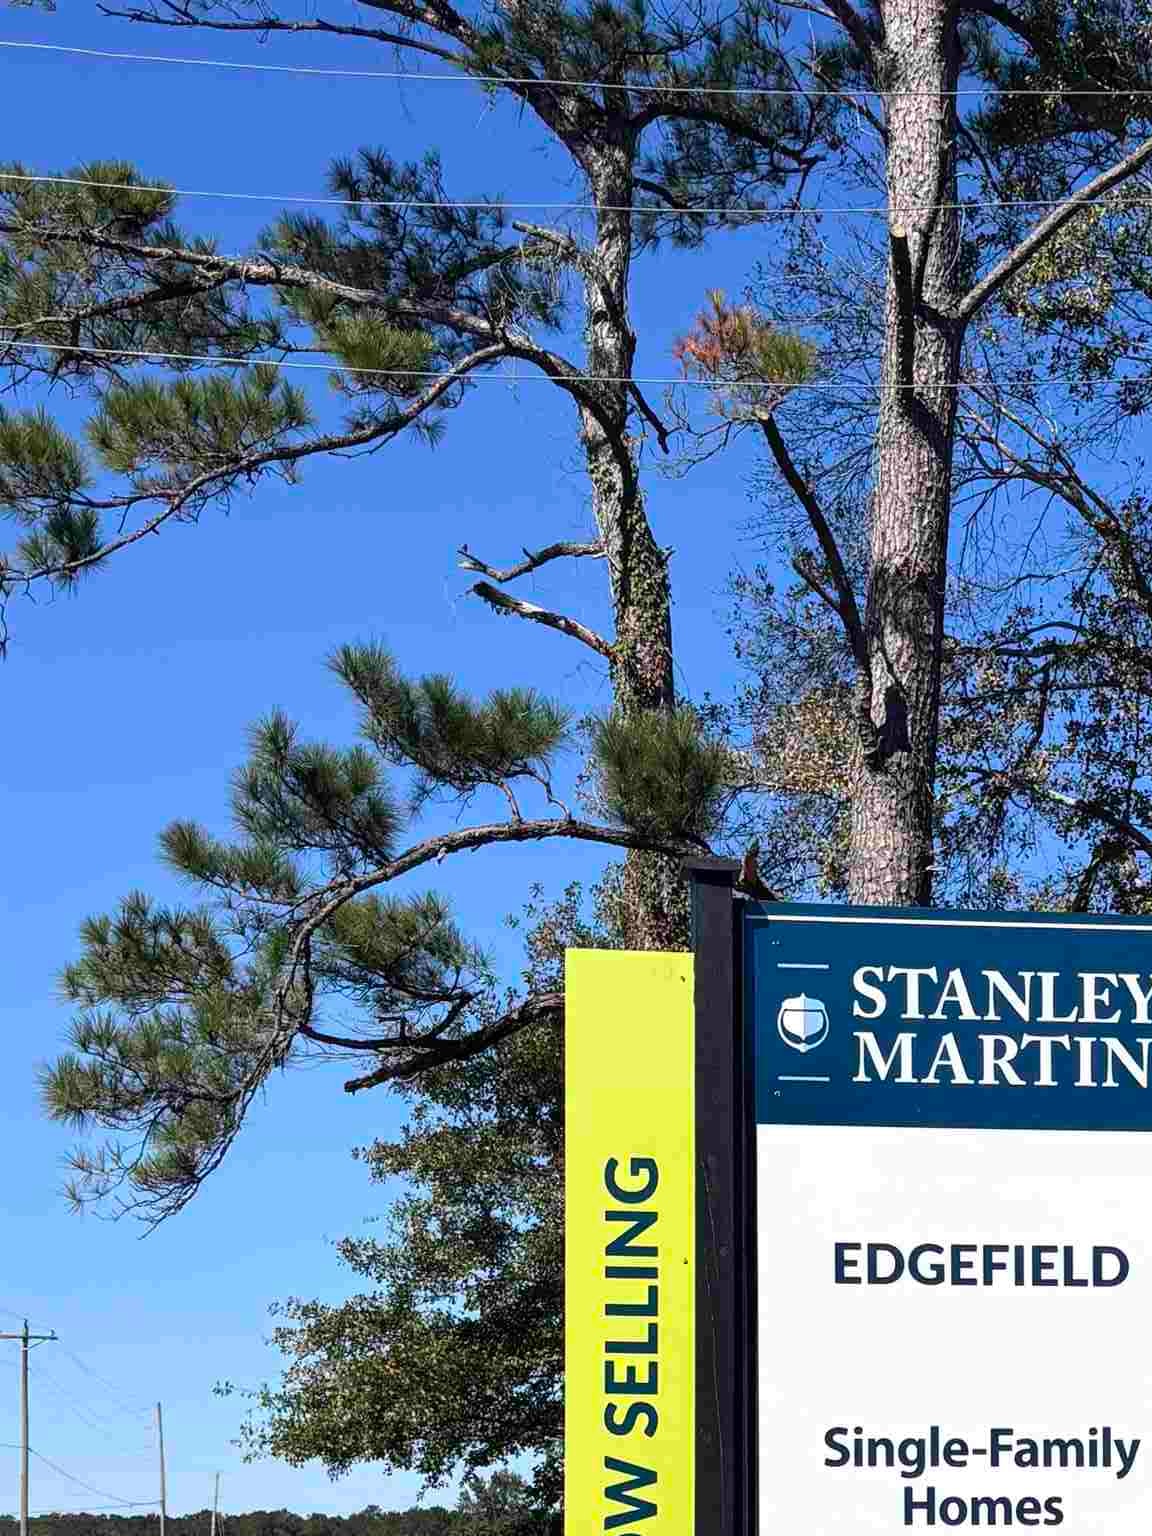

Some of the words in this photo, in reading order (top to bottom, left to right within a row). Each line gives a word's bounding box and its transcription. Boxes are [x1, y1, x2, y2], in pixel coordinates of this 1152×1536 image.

[835, 1243, 1129, 1287] EDGEFIELD
[604, 1158, 658, 1437] SELLING
[825, 1426, 1140, 1479] Single-Family
[904, 1487, 1063, 1525] Homes
